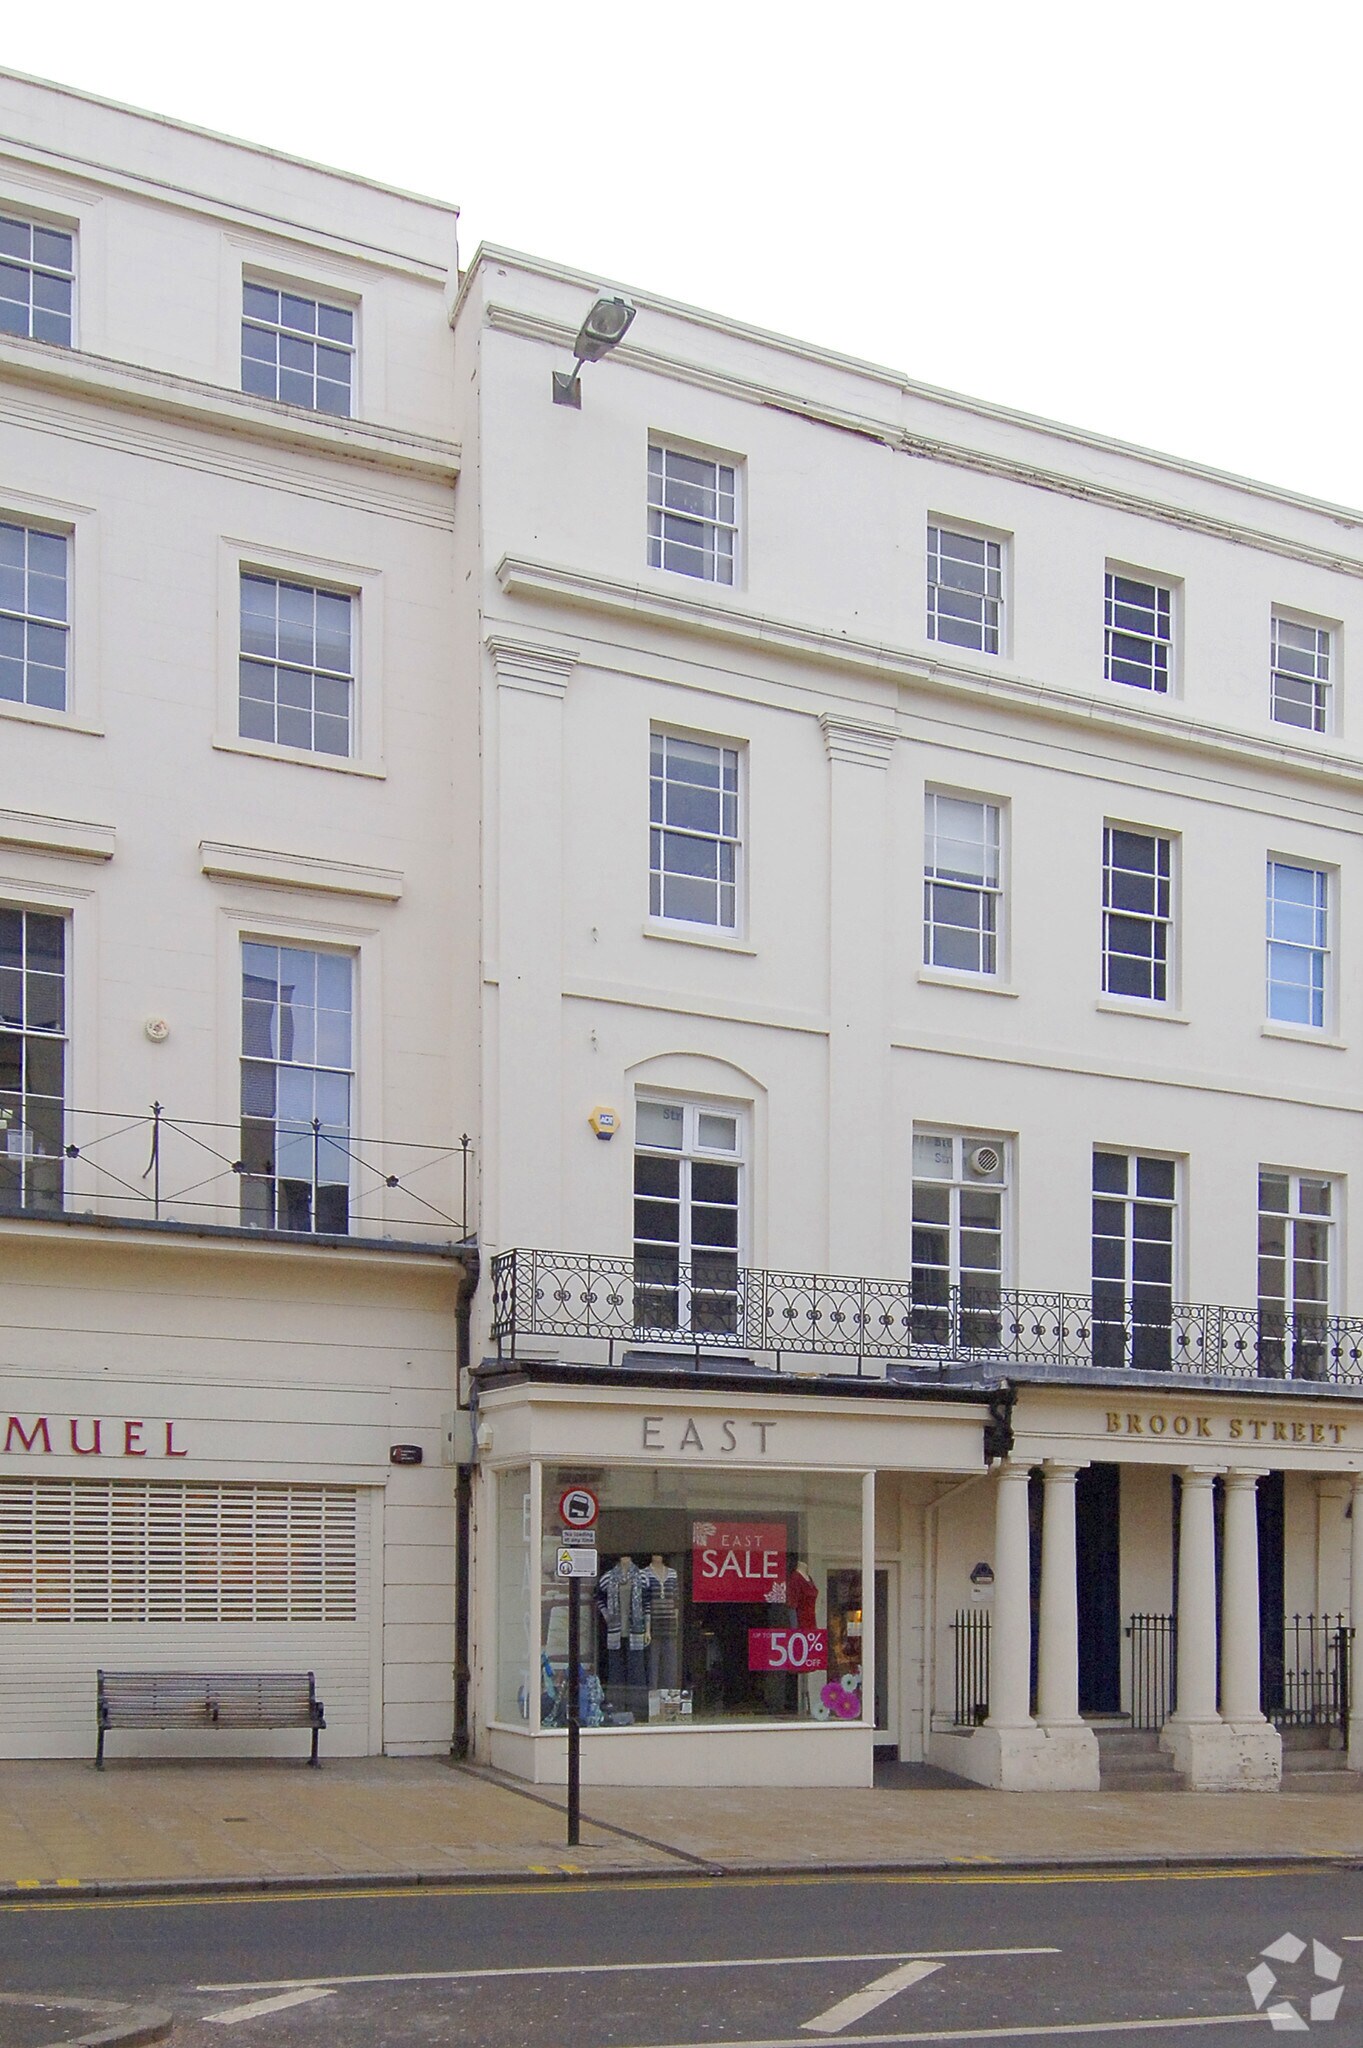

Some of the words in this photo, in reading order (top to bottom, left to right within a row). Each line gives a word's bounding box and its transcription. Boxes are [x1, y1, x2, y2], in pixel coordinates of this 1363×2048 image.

[4, 1416, 188, 1456] MUEL
[643, 1416, 777, 1453] EAST
[1106, 1412, 1213, 1437] BROOK
[1230, 1418, 1347, 1444] STREET
[721, 1535, 763, 1547] EAST
[702, 1550, 778, 1578] SALE
[769, 1632, 823, 1667] 50%
[806, 1659, 821, 1667] OFF
